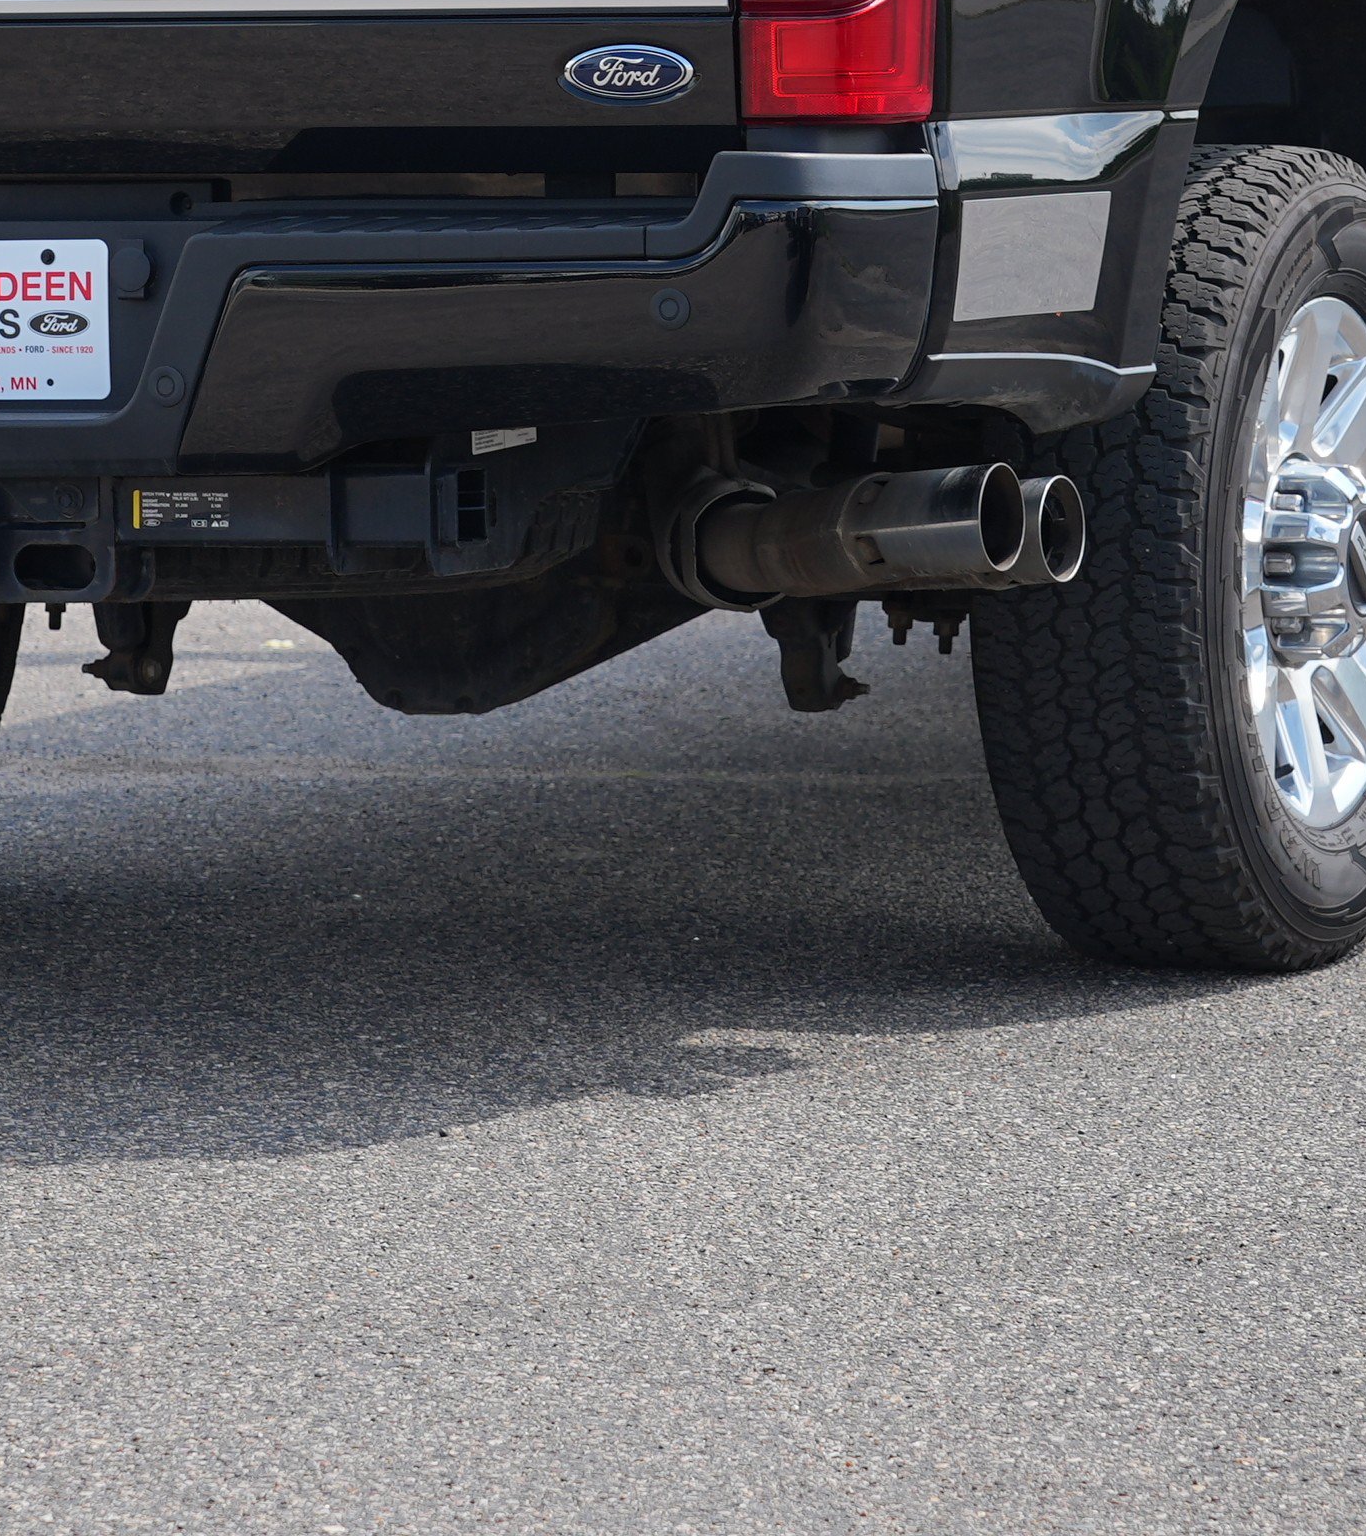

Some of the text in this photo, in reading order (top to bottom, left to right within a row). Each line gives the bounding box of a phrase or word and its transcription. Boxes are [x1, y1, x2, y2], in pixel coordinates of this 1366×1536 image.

[592, 56, 662, 87] Ford
[24, 345, 45, 354] FORD
[51, 345, 73, 354] SINCE
[75, 346, 94, 354] 1920
[10, 376, 38, 391] MN
